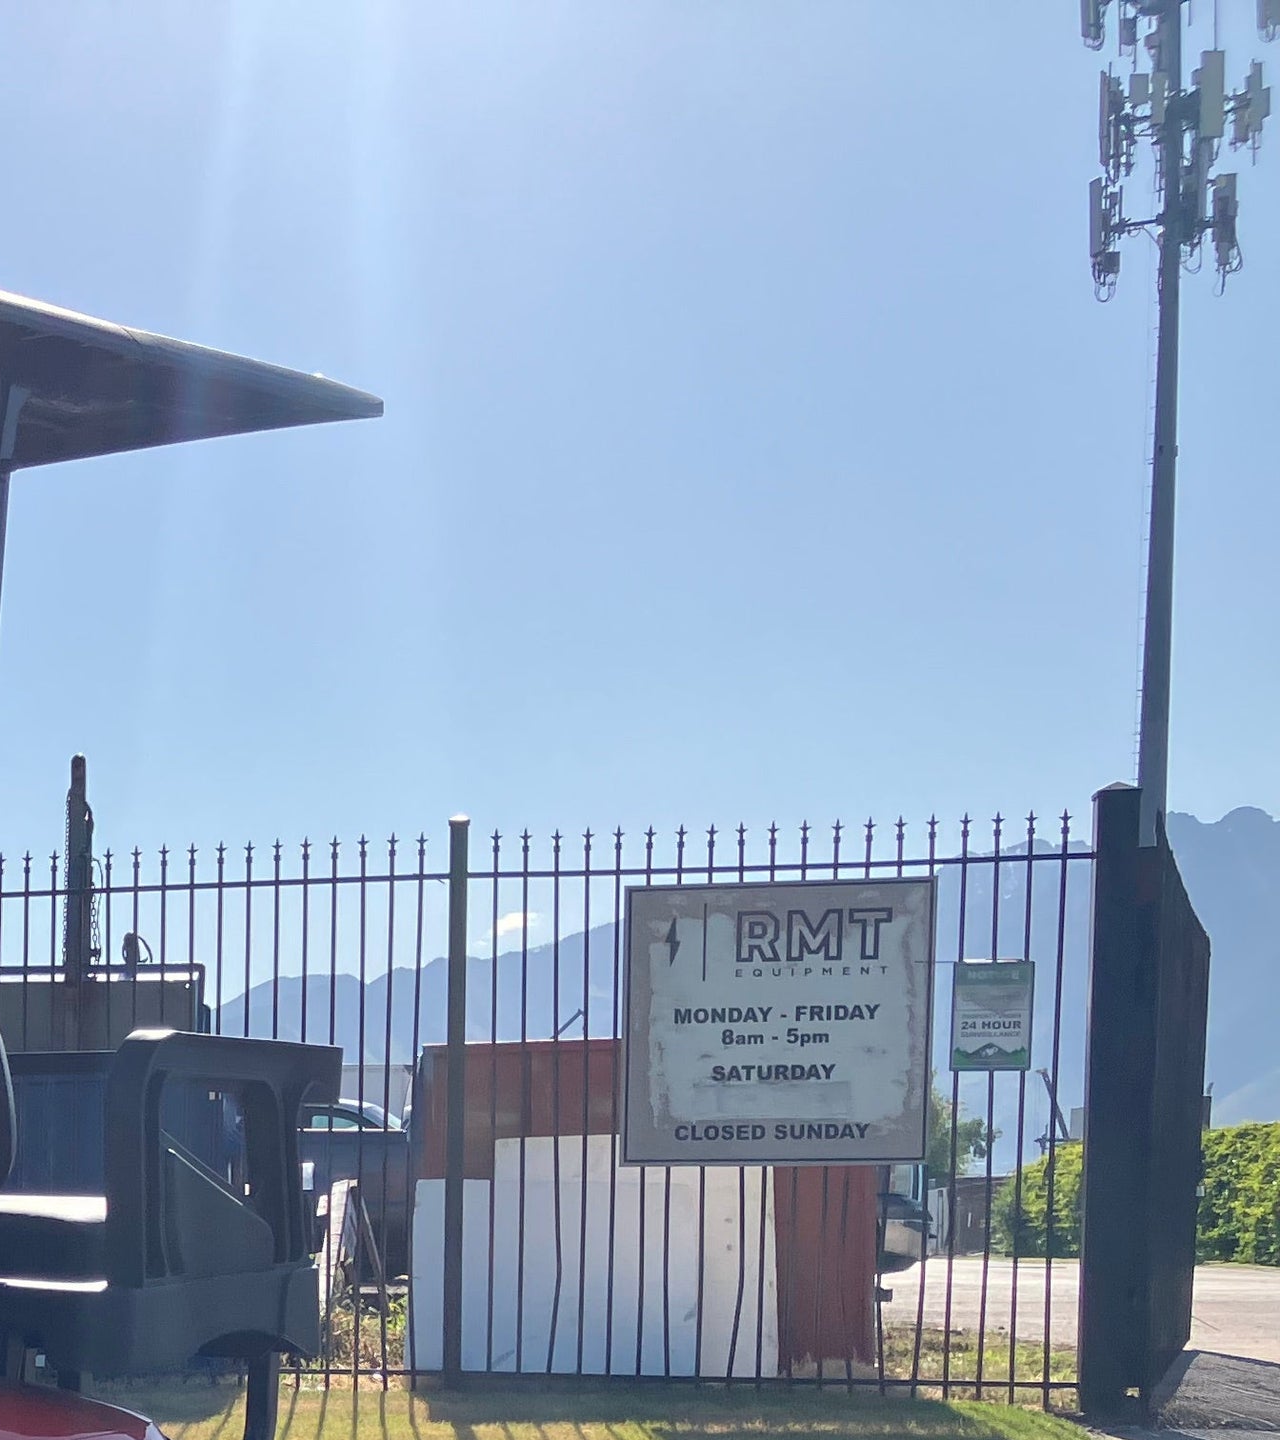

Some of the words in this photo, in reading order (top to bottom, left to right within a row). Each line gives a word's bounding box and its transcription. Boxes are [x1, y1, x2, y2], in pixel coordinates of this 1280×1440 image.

[736, 907, 893, 962] RMT
[735, 966, 888, 978] EQUIPMENT
[674, 1006, 773, 1024] MONDAY
[795, 1003, 880, 1022] FRIDAY
[961, 1021, 977, 1030] 24
[981, 1020, 1021, 1030] HOUR
[721, 1029, 764, 1045] 8am
[786, 1028, 829, 1047] 5pm
[711, 1064, 836, 1081] SATURDAY
[674, 1124, 766, 1141] CLOSED
[774, 1122, 871, 1140] SUNDAY
